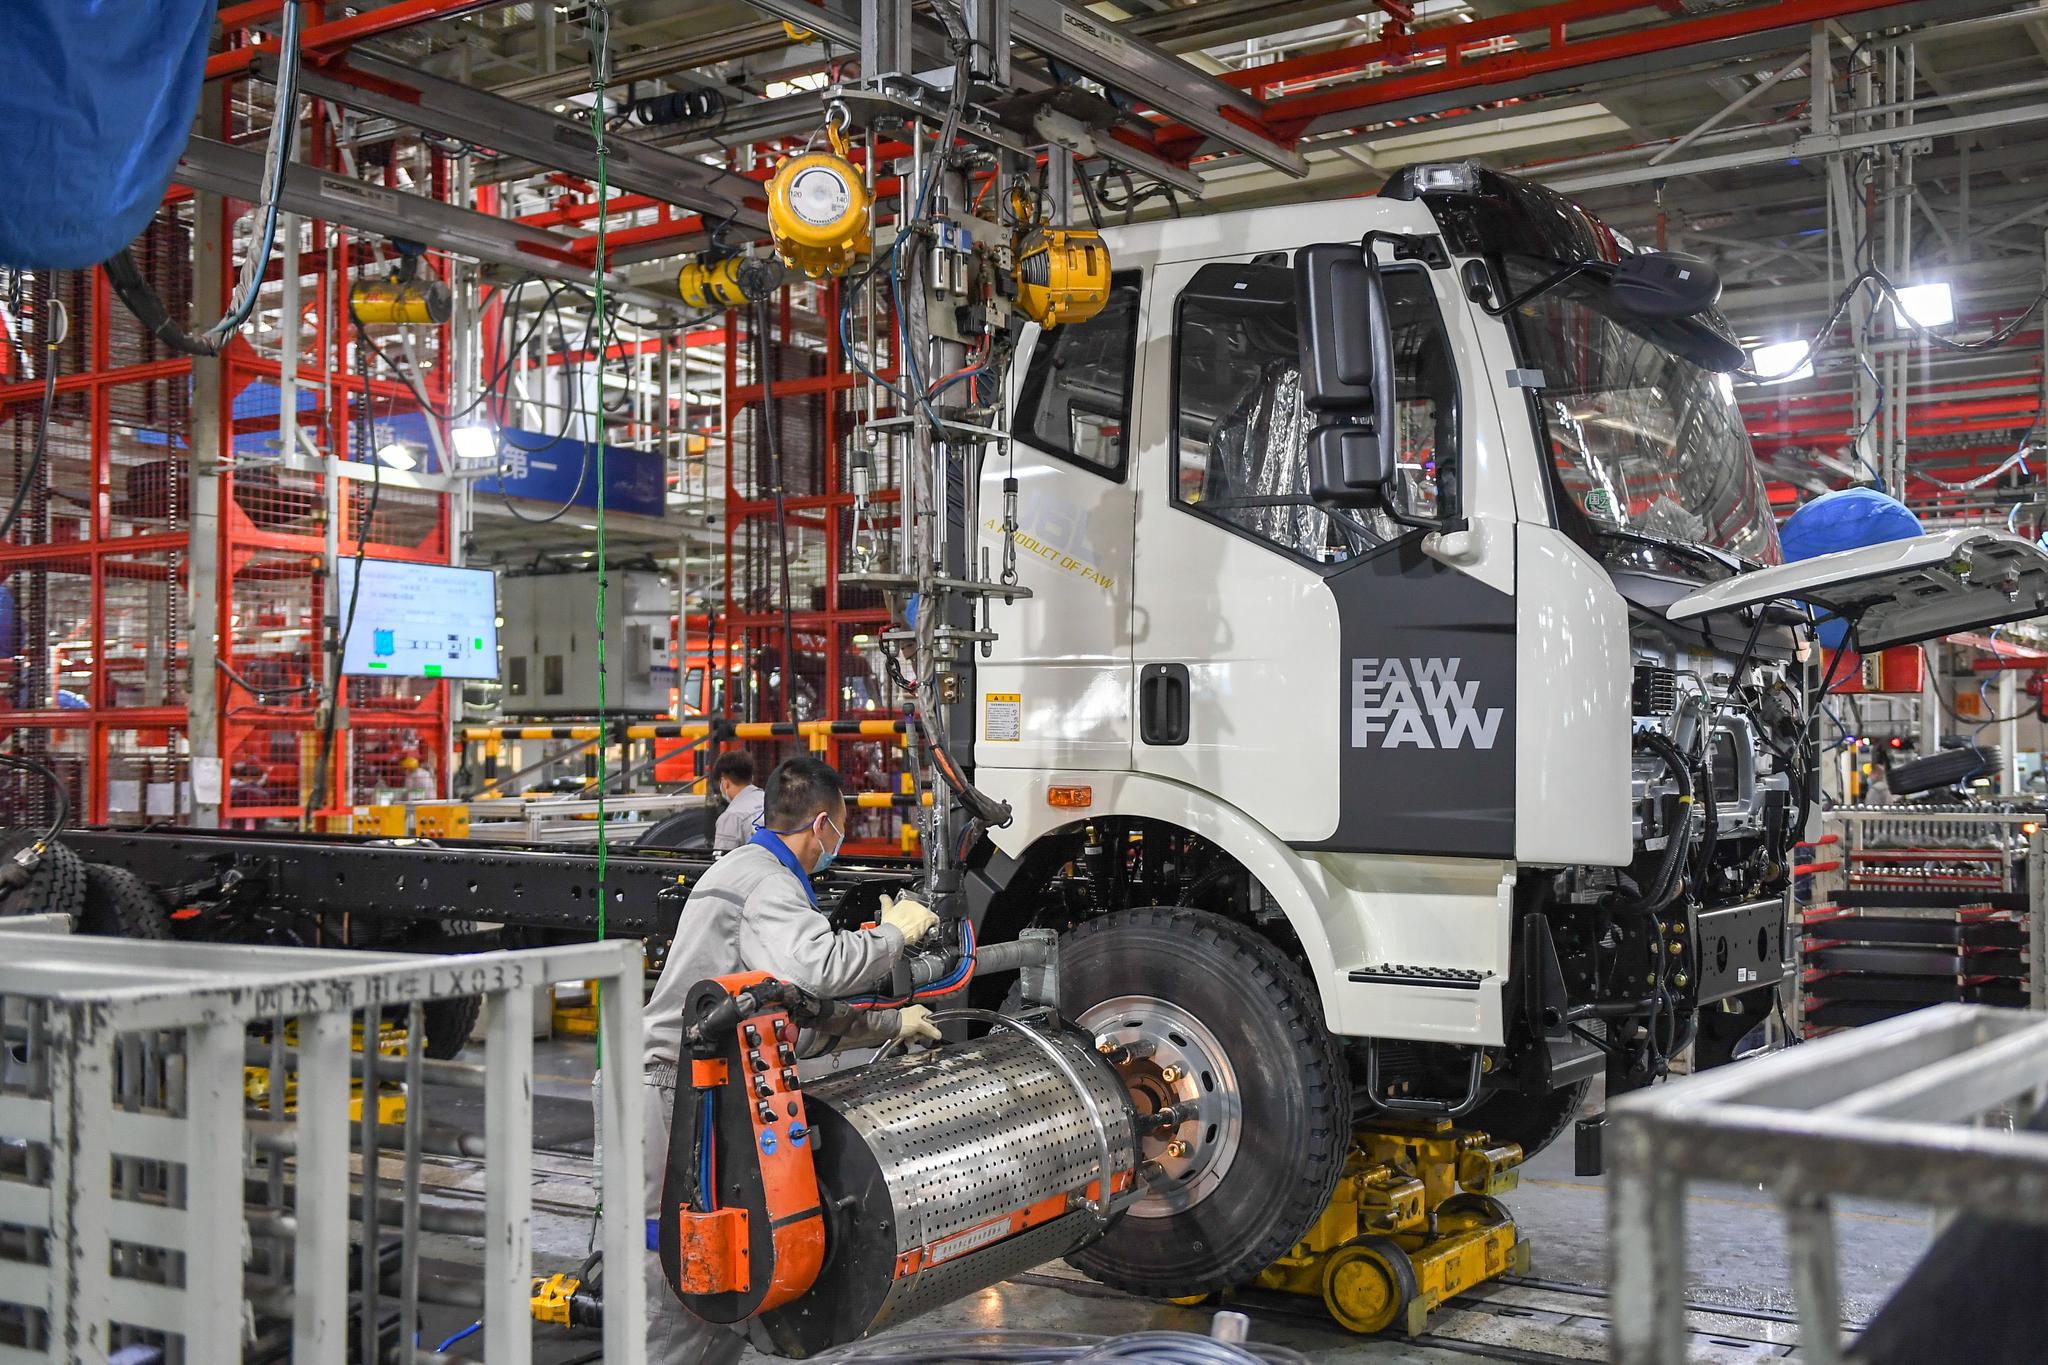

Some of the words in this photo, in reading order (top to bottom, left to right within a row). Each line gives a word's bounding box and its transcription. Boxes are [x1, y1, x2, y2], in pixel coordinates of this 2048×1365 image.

[984, 519, 996, 530] A
[997, 527, 1061, 561] PODUCT
[1060, 557, 1081, 571] OF
[1081, 567, 1114, 589] FAW
[1352, 658, 1461, 687] FAW
[1352, 681, 1480, 715] FAW
[1352, 708, 1504, 749] FAW
